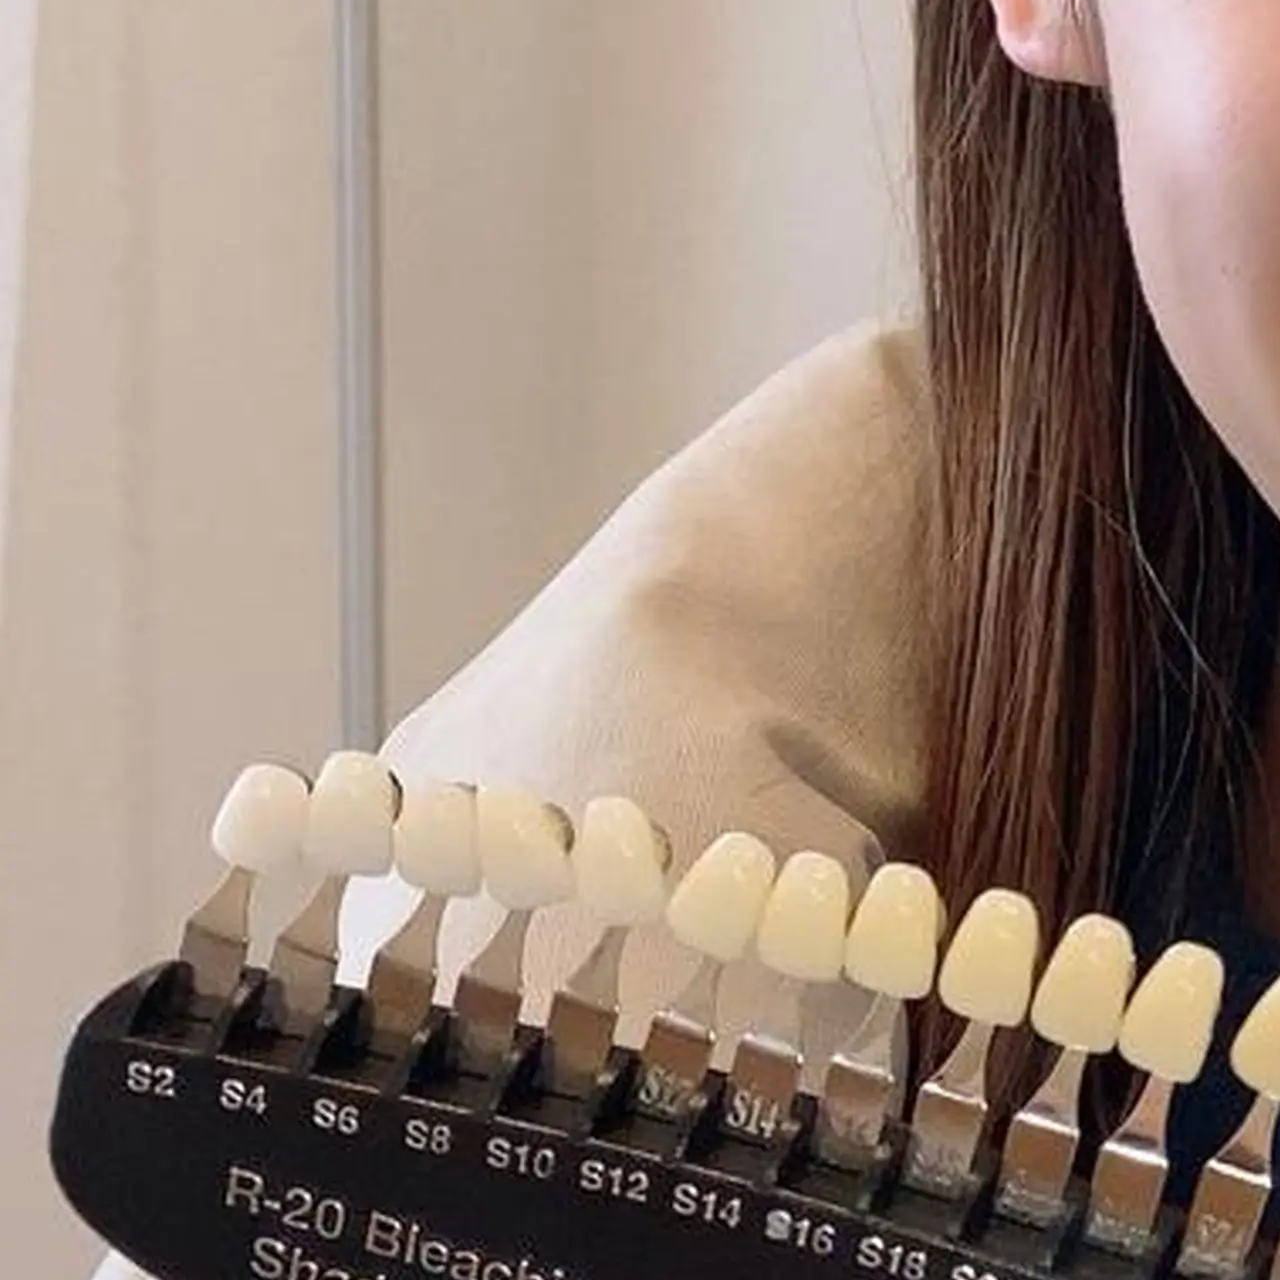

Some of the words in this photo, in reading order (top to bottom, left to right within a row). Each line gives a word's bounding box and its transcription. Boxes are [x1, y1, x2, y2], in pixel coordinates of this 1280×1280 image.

[126, 1061, 176, 1095] S2
[220, 1078, 268, 1114] S4
[313, 1098, 360, 1134] S6
[405, 1118, 451, 1154] S8
[487, 1138, 556, 1178] S10
[580, 1160, 650, 1202] S12
[672, 1182, 742, 1227] S14
[857, 1235, 927, 1280] S18
[224, 1166, 345, 1240] R-20
